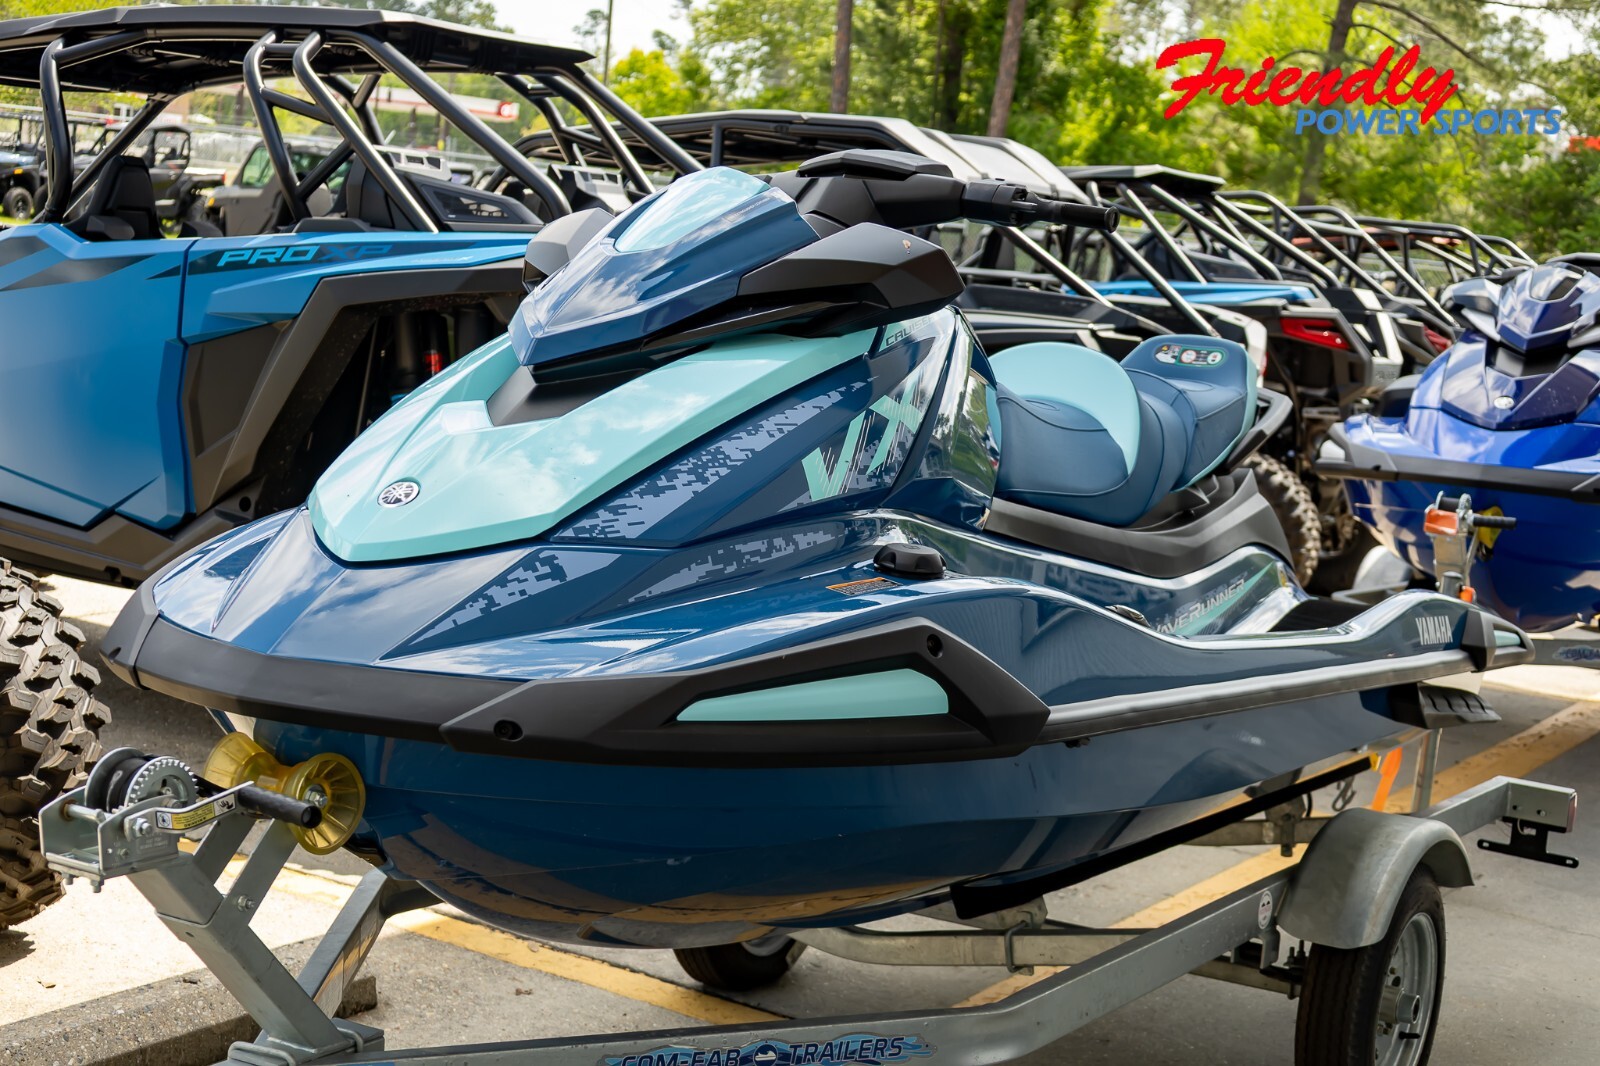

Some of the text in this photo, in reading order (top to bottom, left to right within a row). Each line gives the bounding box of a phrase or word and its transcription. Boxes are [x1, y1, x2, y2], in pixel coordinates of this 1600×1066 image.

[216, 244, 393, 267] PRO XP
[801, 366, 925, 502] VX
[1415, 615, 1453, 646] YAMAHA
[788, 1036, 906, 1066] TRAILERS
